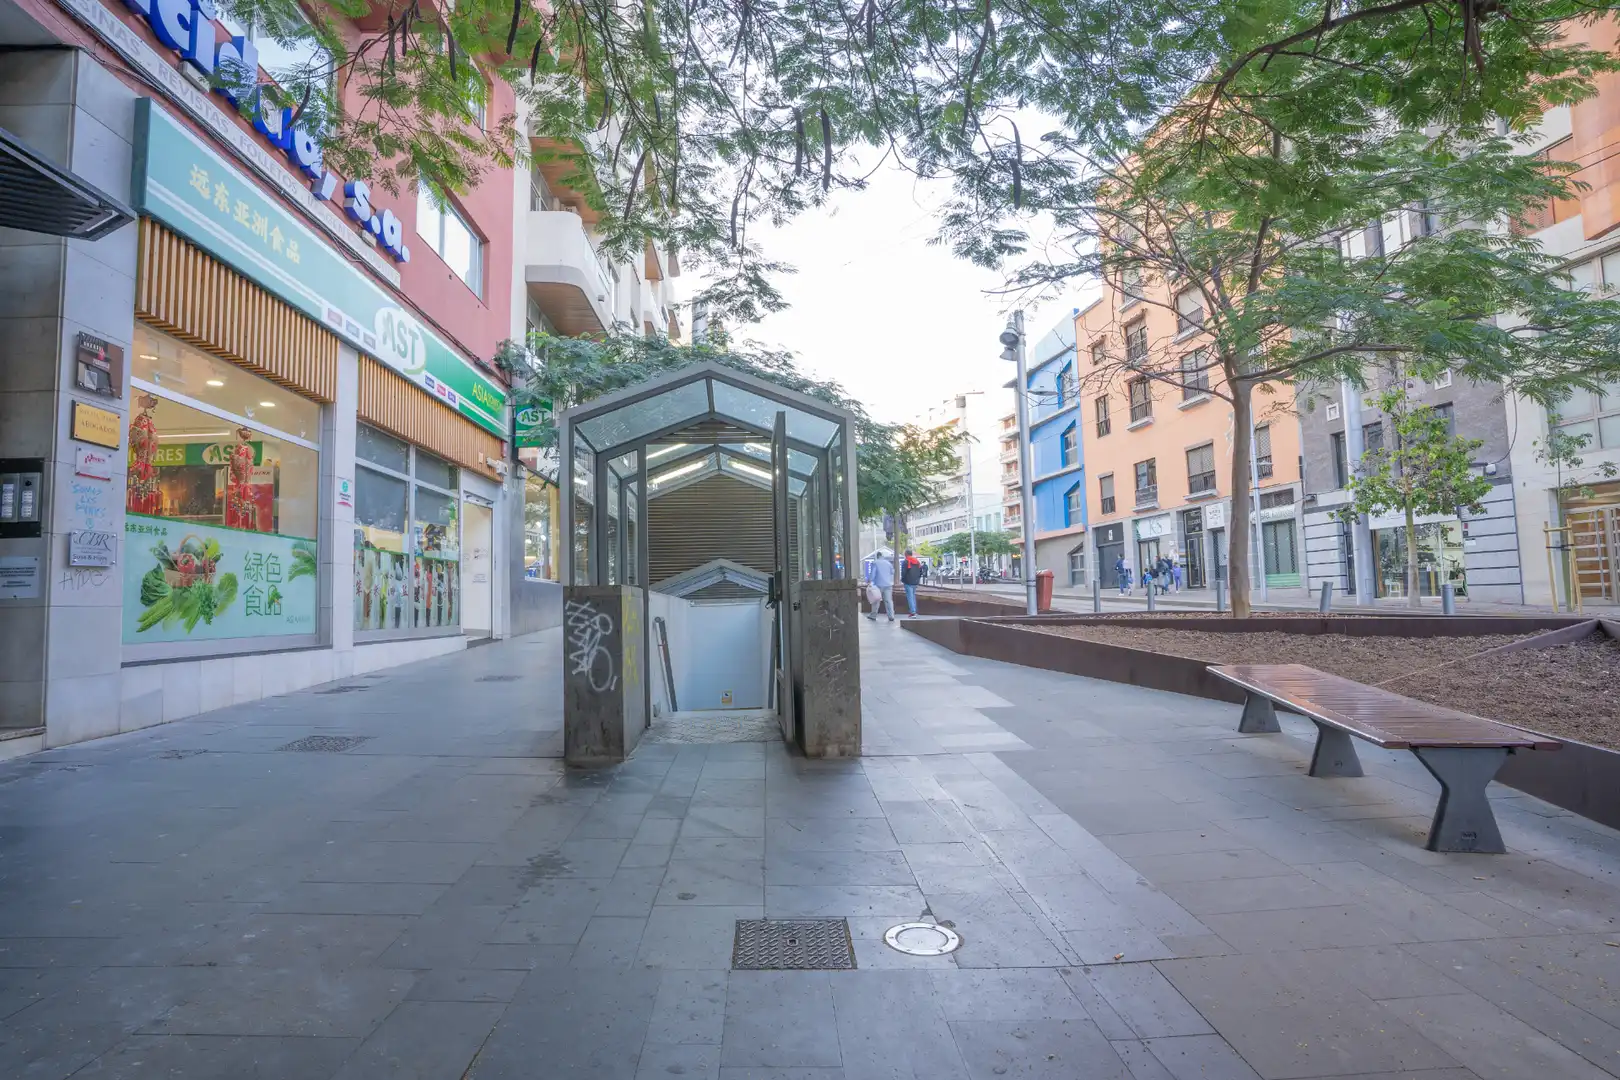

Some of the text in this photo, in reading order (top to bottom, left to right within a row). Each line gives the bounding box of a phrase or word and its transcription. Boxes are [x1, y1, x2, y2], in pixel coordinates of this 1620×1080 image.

[158, 63, 229, 132] REVISTAS
[240, 136, 298, 194] FOLLETOS
[382, 311, 419, 366] AST
[520, 410, 547, 424] AST
